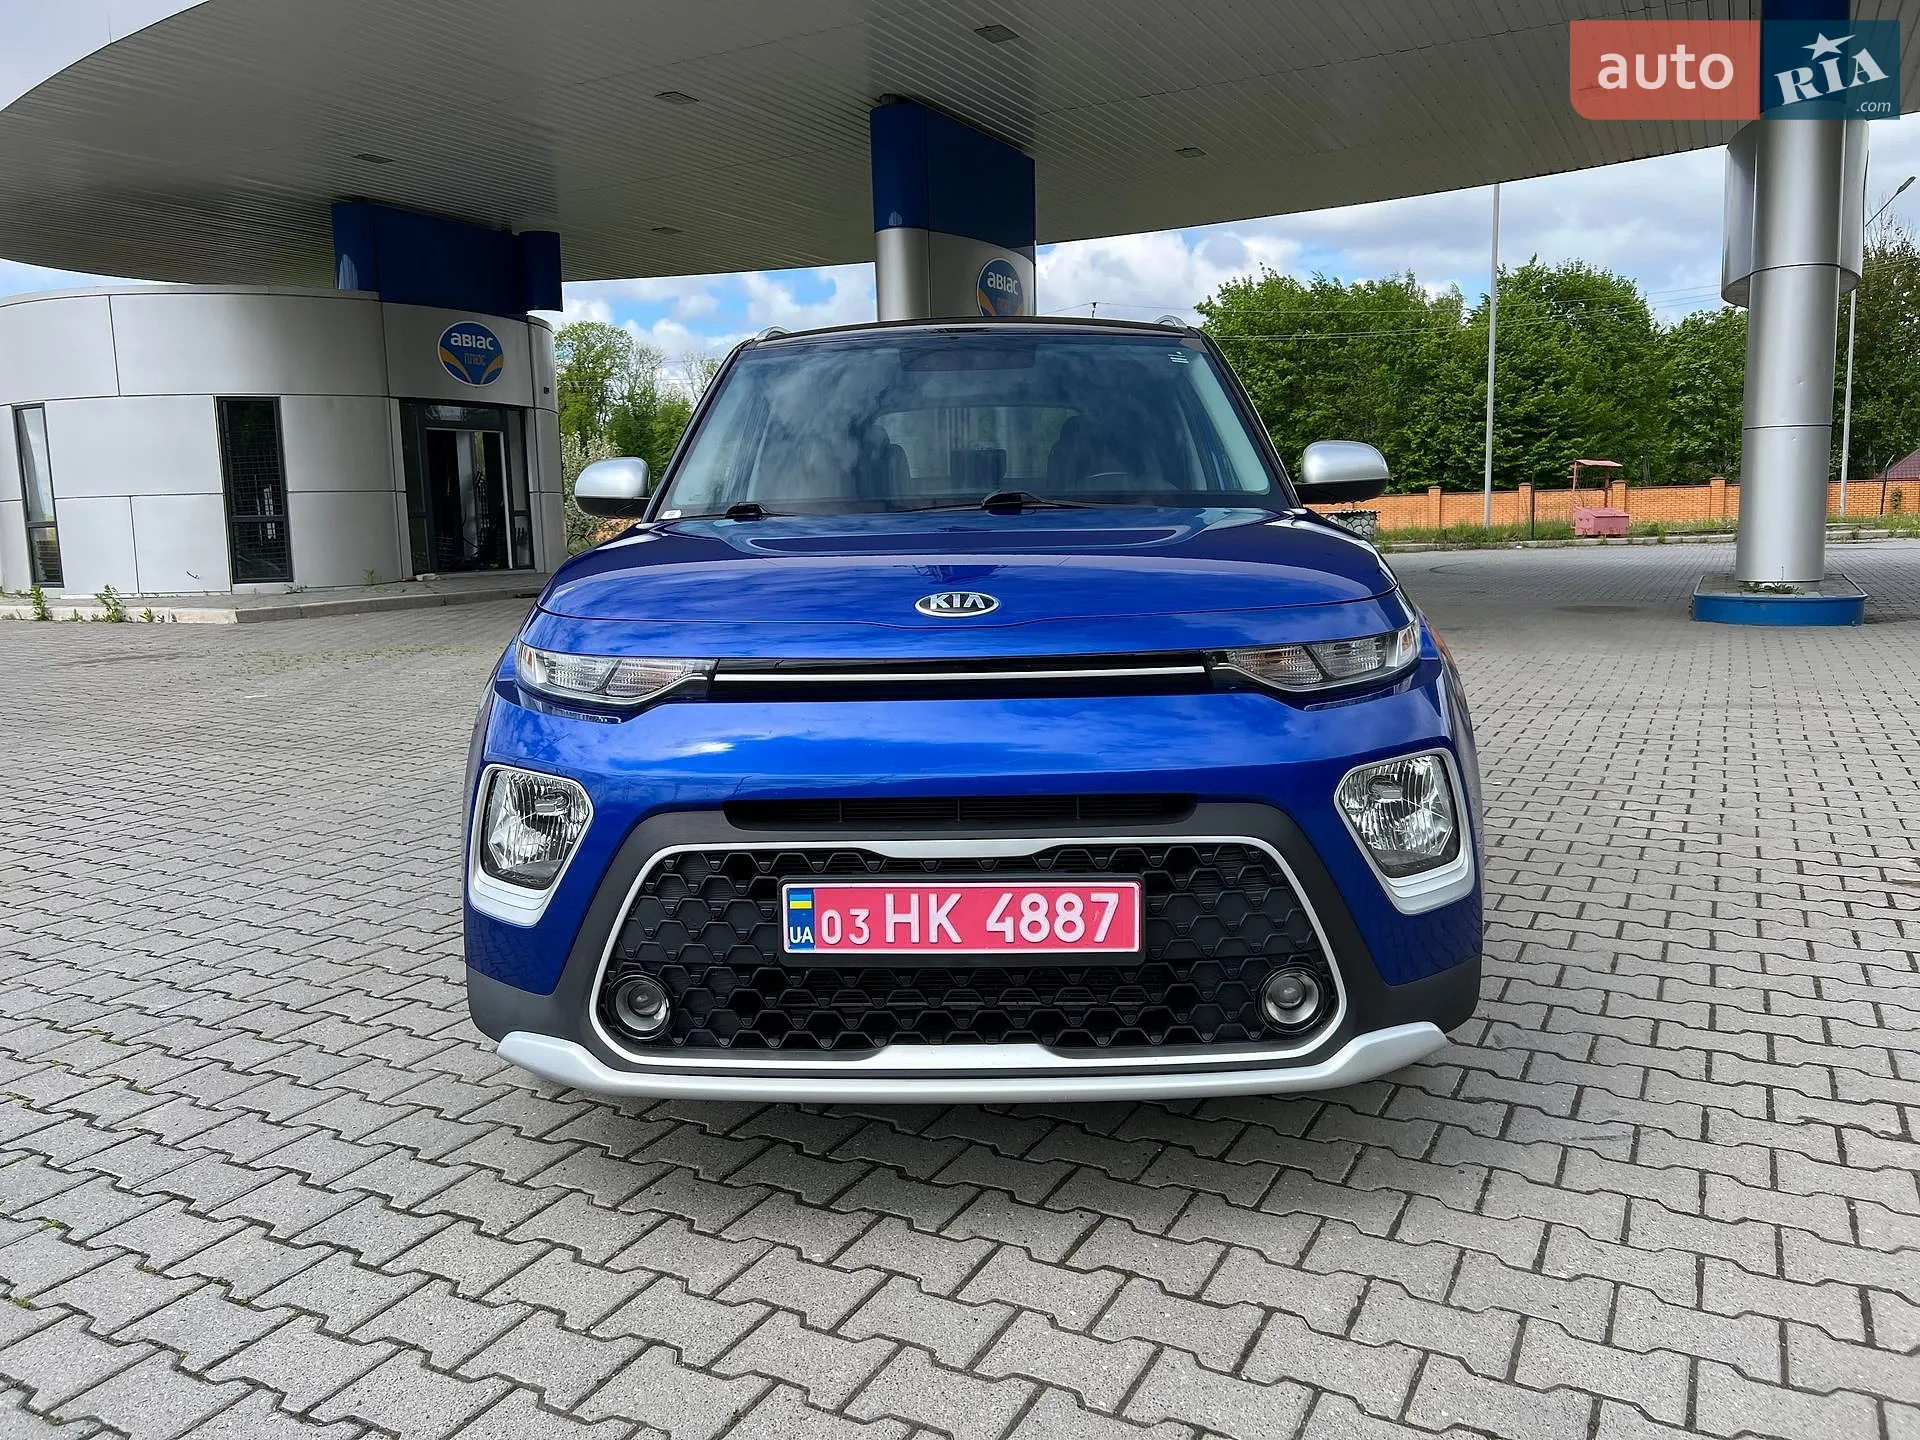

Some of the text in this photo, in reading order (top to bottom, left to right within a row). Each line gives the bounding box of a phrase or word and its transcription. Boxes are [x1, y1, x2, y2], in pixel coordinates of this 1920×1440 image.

[929, 593, 986, 610] KIA
[820, 892, 1119, 945] 03 HK 4887
[789, 926, 814, 944] UA
